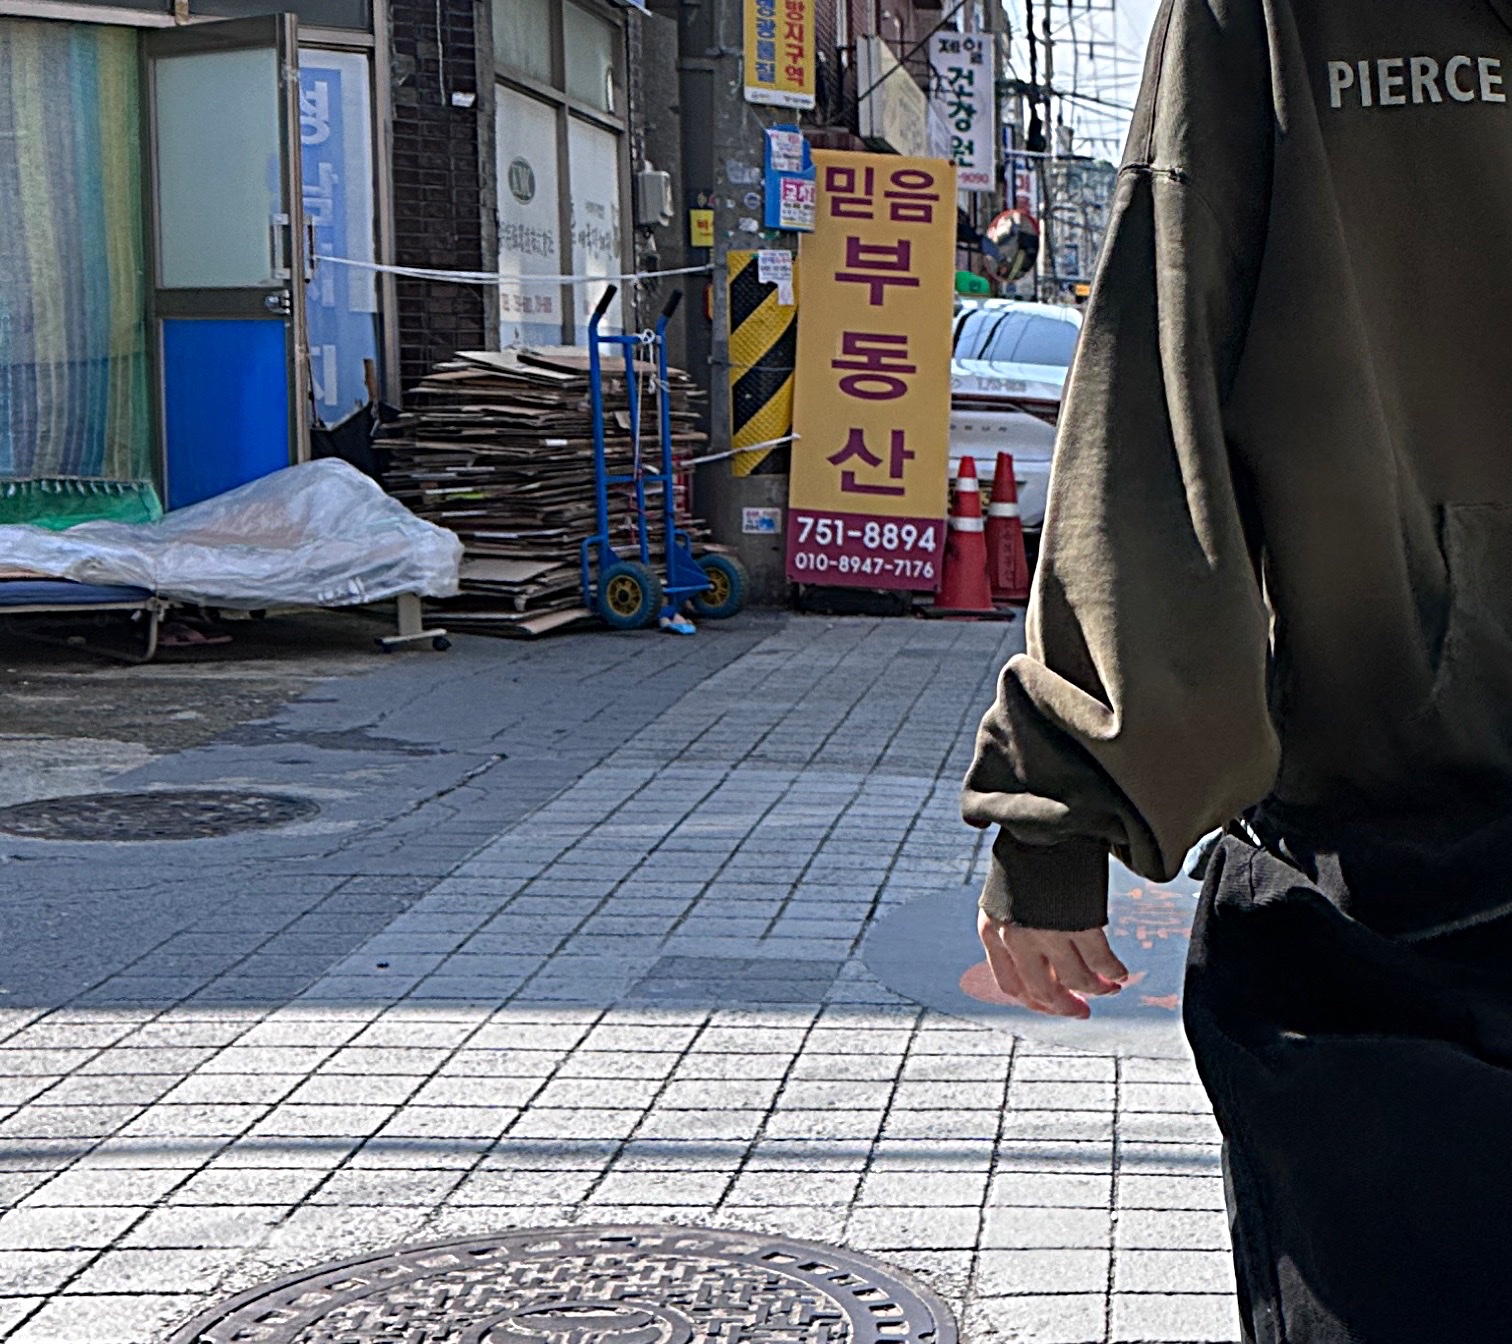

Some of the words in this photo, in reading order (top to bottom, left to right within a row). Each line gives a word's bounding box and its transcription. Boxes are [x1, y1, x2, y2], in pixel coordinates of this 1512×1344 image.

[938, 37, 983, 65] 제일
[1328, 56, 1505, 108] PIERCE
[826, 167, 940, 225] 믿음
[827, 237, 920, 497] 부동산
[797, 518, 935, 552] 751-8894
[795, 551, 934, 580] 010-8947-7176
